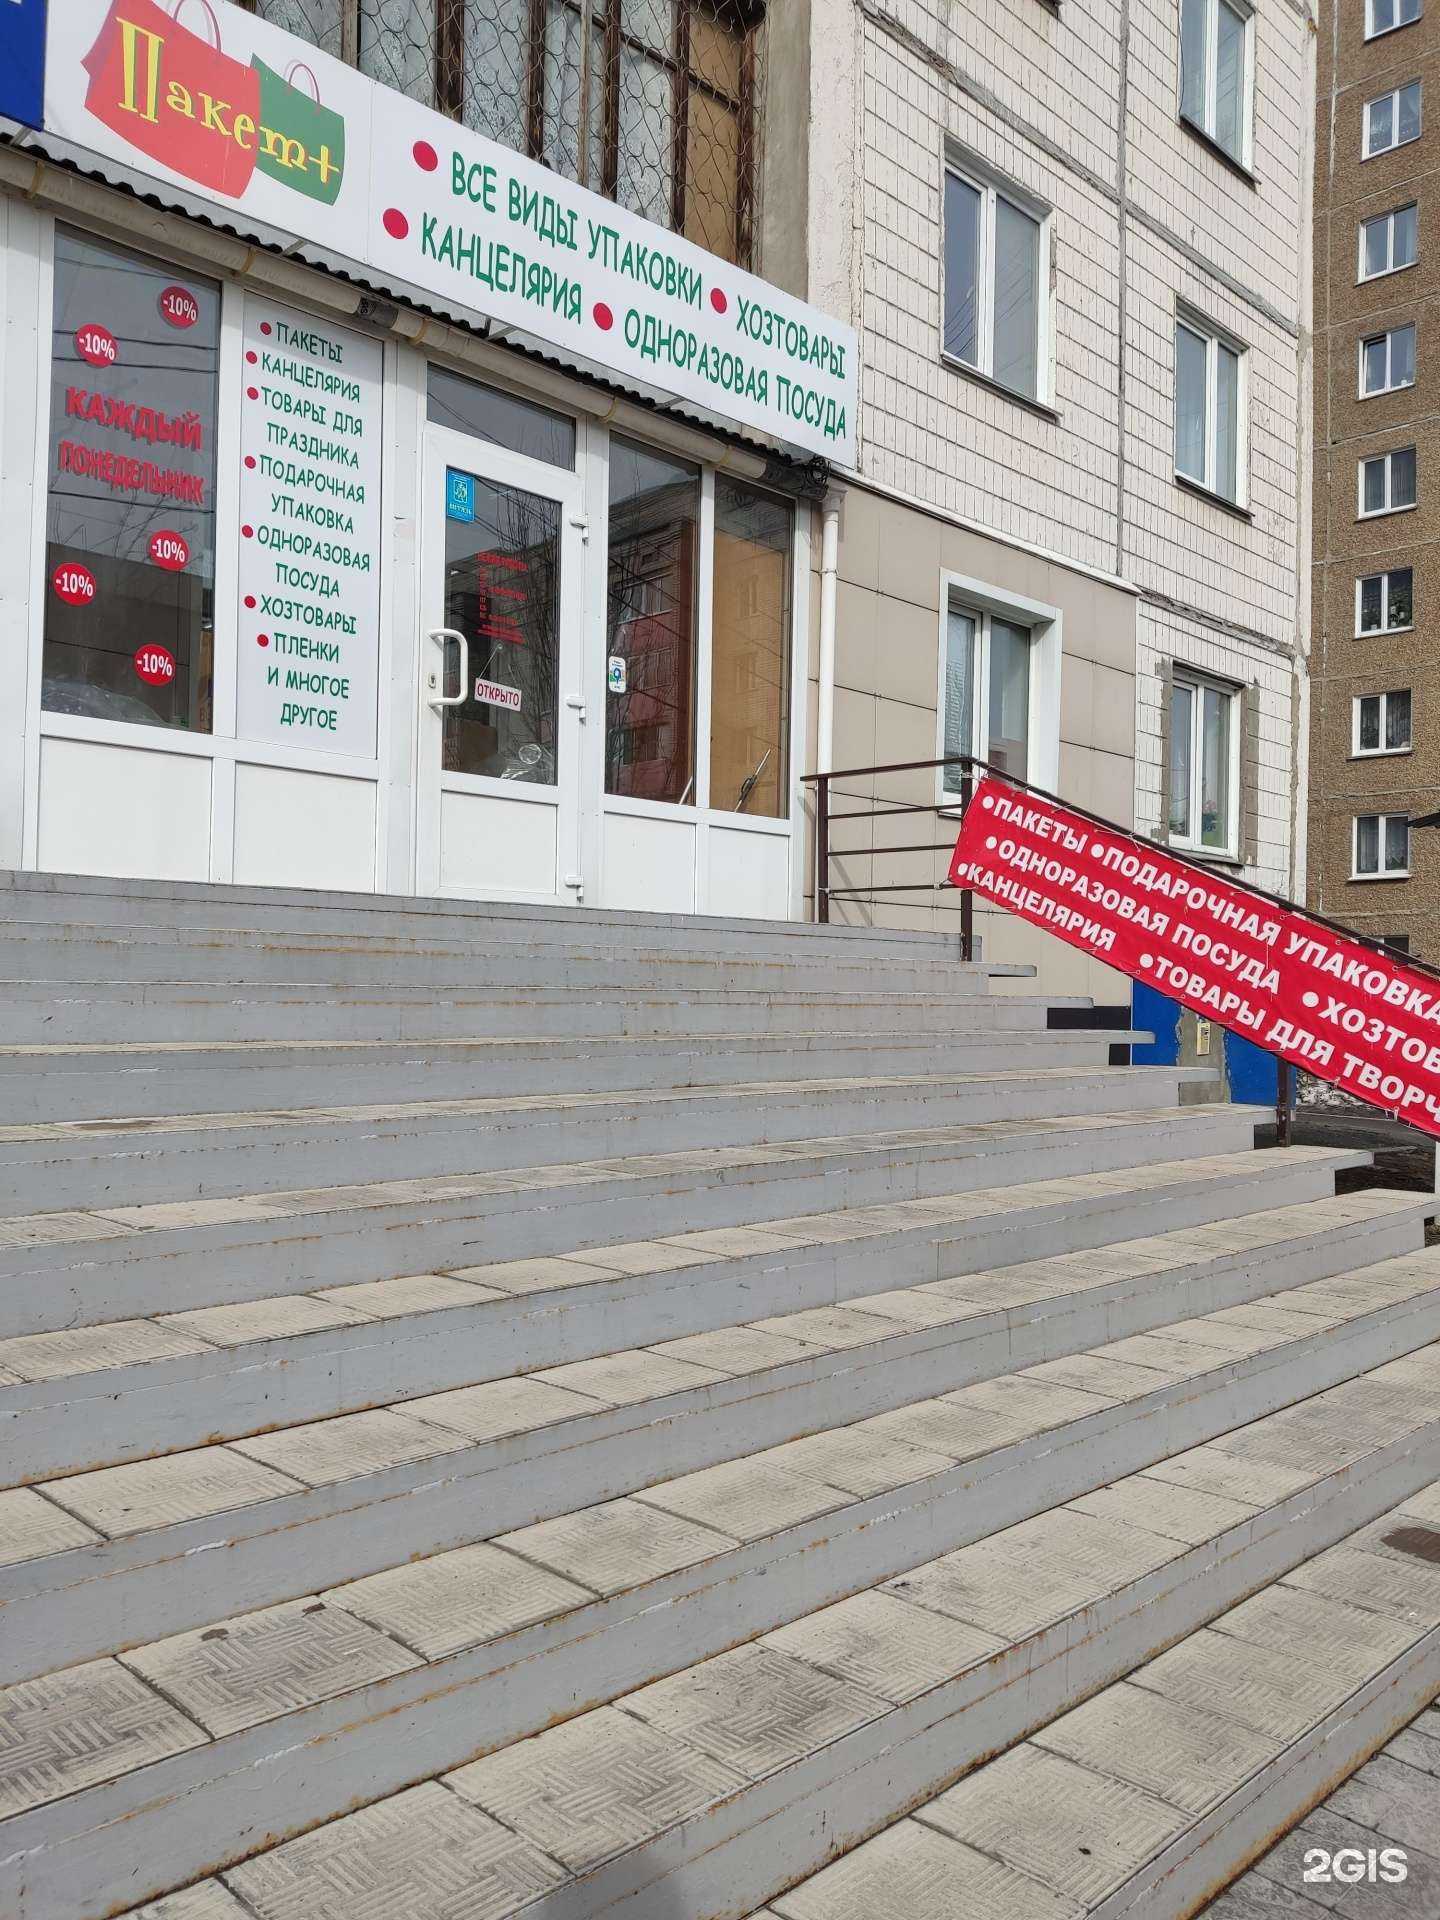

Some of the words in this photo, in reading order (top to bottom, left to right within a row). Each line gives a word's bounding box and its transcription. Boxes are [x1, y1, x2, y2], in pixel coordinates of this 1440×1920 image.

[451, 151, 497, 213] ВСЕ
[508, 177, 578, 251] ВИДЫ
[588, 218, 702, 311] УПАКОВКИ
[736, 294, 846, 380] ХОЗТОВАРЫ
[162, 295, 197, 322] -10%
[422, 212, 582, 325] КАНЦЕЛЯРИЯ
[624, 309, 768, 404] ОДНОРАЗОВАЯ
[776, 374, 846, 441] ПОСУДА
[78, 334, 116, 361] -10%
[276, 321, 343, 363] ПАКЕТЫ
[262, 351, 361, 403] КАНЦЕЛЯРИЯ
[66, 387, 202, 450] КАЖДЫЙ
[261, 386, 327, 426] ТОВАРЫ
[332, 411, 363, 438] ДЛЯ
[267, 422, 360, 470] ПРАЗДНИКА
[58, 440, 204, 505] ПОНЕДЕЛЬНИК
[259, 454, 365, 505] ПОДАРОЧНАЯ
[271, 493, 354, 534] УПАКОВКА
[151, 540, 186, 565] -10%
[257, 525, 370, 572] ОДНОРАЗОВАЯ
[54, 575, 94, 599] -10%
[275, 562, 340, 598] ПОСУДА
[260, 594, 357, 635] ХОЗТОВАРЫ
[136, 653, 173, 677] -10%
[273, 632, 340, 664] ПЛЕНКИ
[267, 665, 279, 687] И
[285, 669, 350, 699] МНОГОЕ
[477, 683, 520, 706] ОТКРЫТО
[280, 702, 338, 731] ДРУГОЕ
[993, 801, 1086, 853] ПАКЕТЫ
[1102, 847, 1284, 947] ПОДАРОЧНАЯ
[1285, 929, 1440, 1027] УПАКОВКА
[998, 839, 1169, 937] ОДНОРАЗОВАЯ
[1173, 923, 1281, 995] ПОСУДА
[967, 862, 1117, 952] КАНЦЕЛЯРИЯ
[1154, 955, 1266, 1030] ТОВАРЫ
[1266, 1018, 1335, 1067] ДЛЯ
